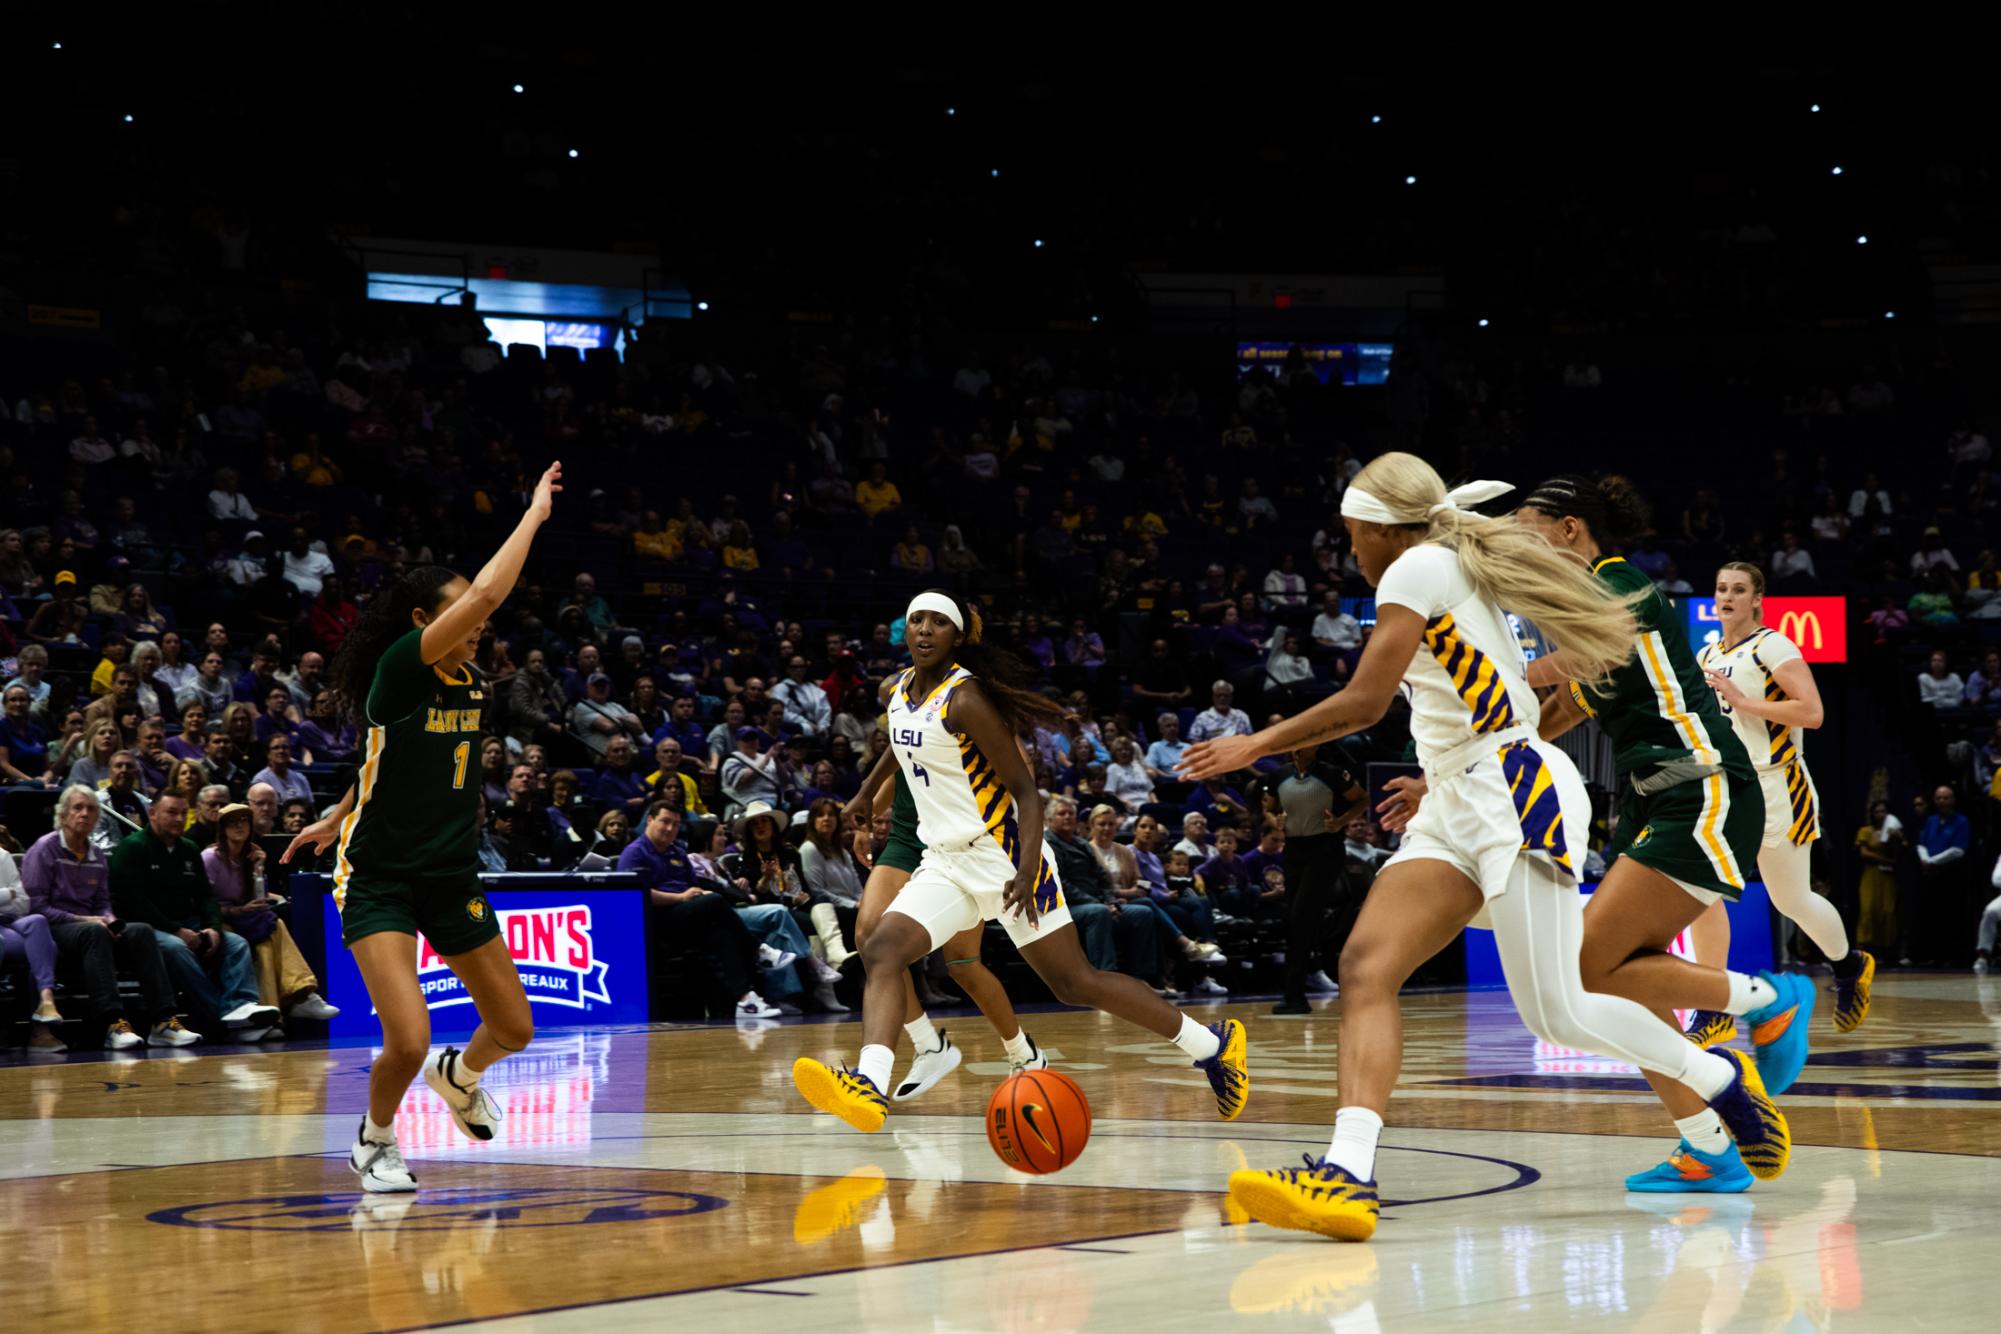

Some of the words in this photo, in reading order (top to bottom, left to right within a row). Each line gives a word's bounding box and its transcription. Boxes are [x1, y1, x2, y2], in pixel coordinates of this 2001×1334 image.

[893, 727, 922, 748] LSU
[452, 741, 471, 790] 1
[906, 751, 930, 787] 4
[995, 1106, 1020, 1163] ELITE
